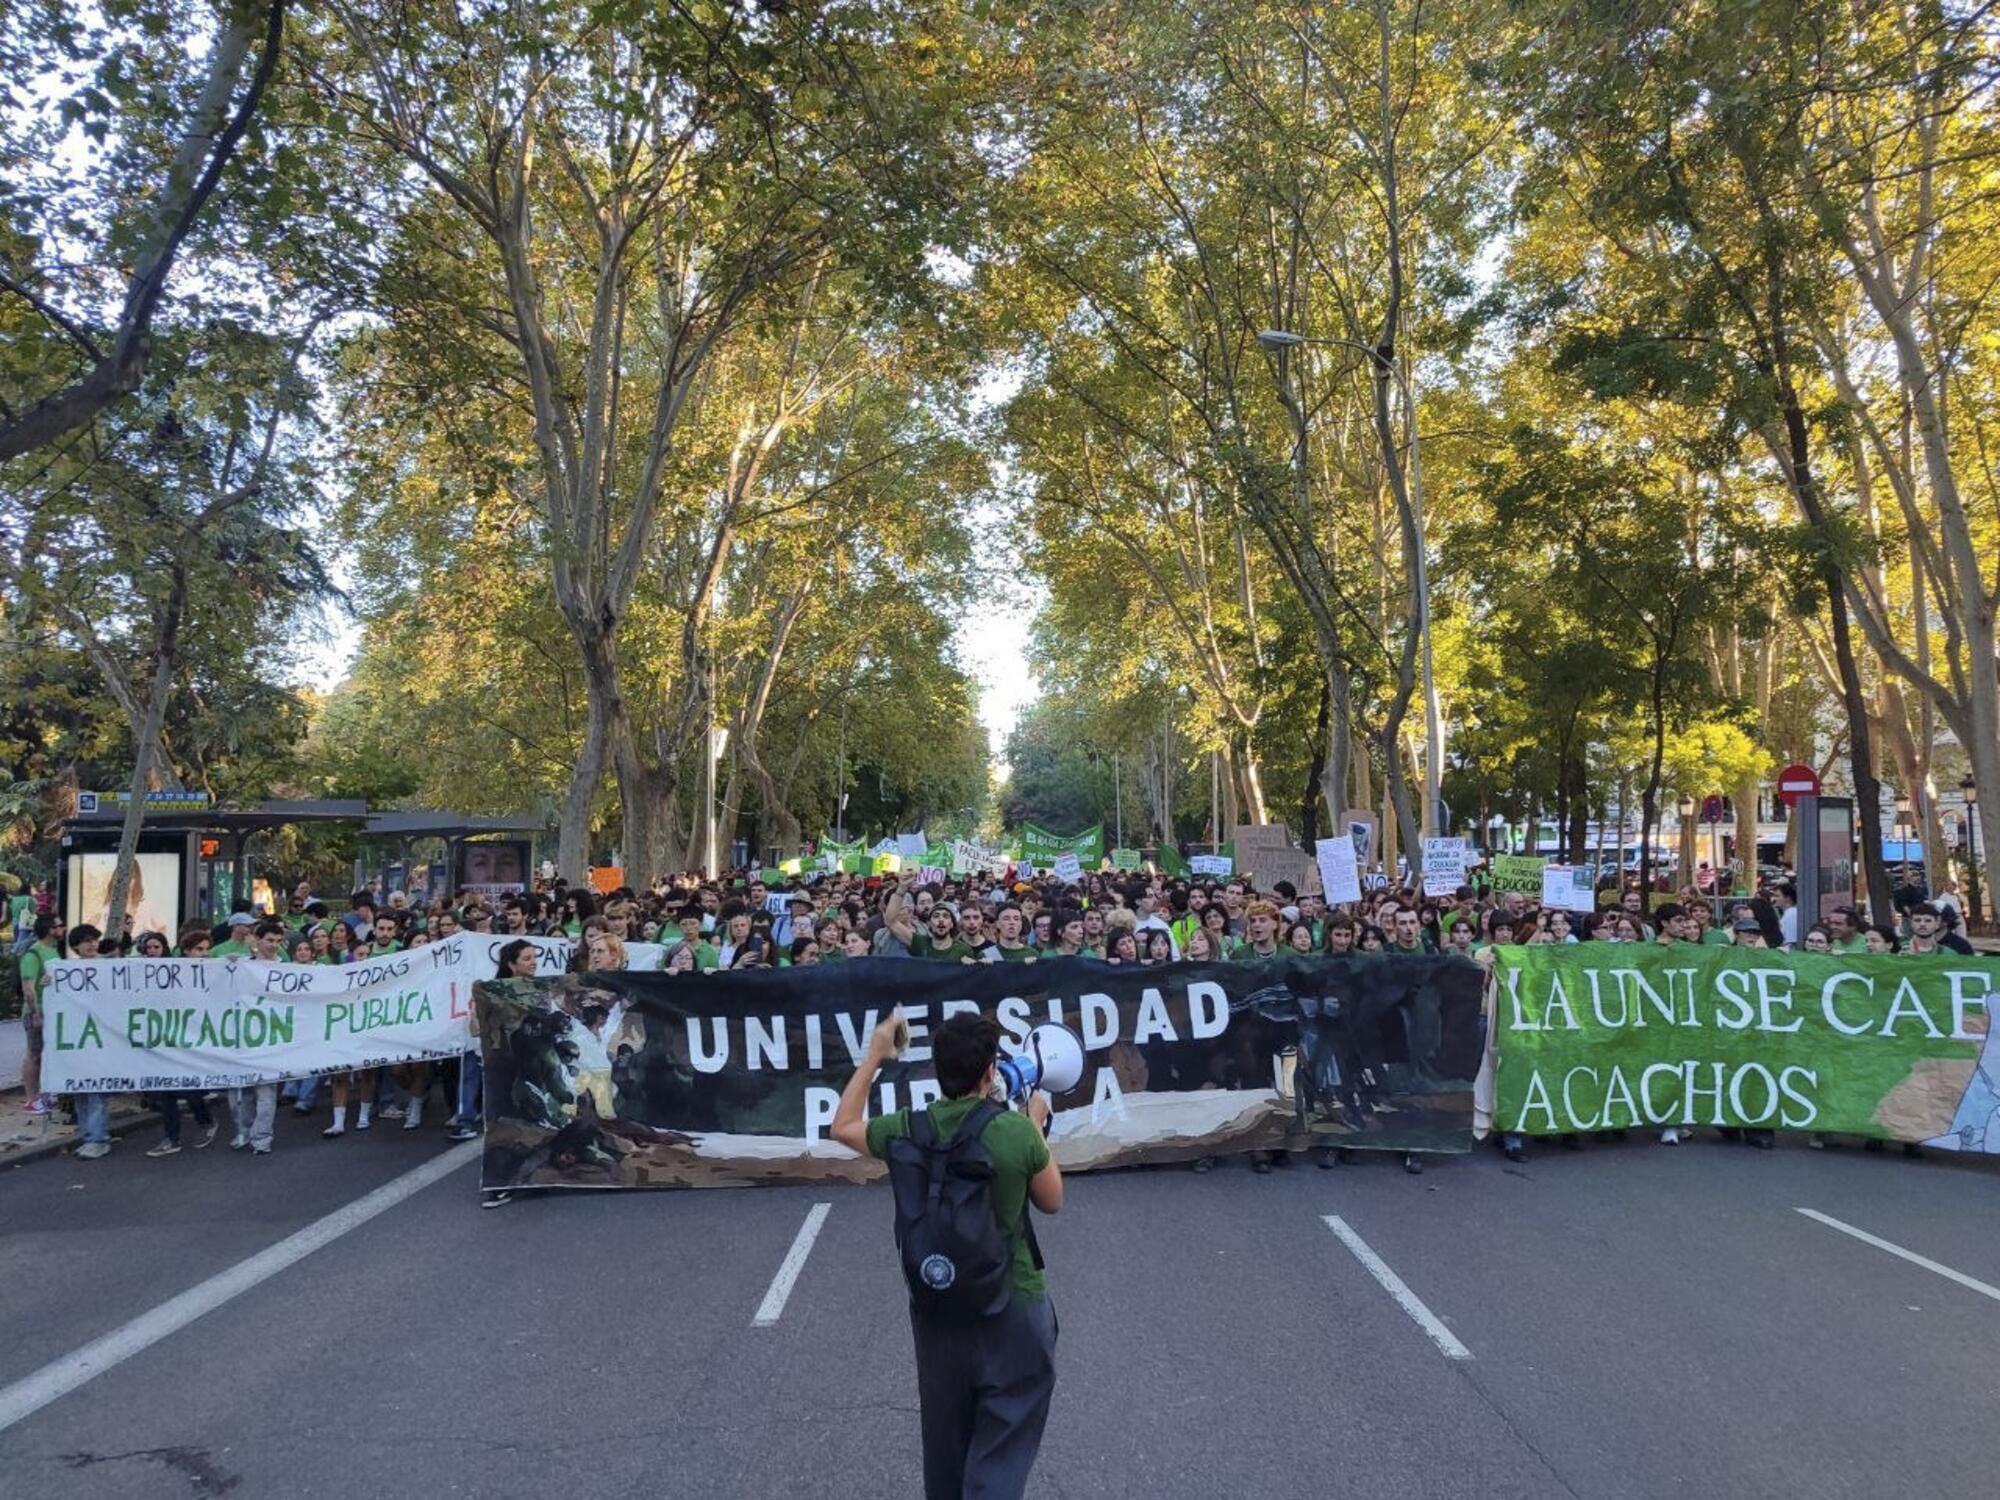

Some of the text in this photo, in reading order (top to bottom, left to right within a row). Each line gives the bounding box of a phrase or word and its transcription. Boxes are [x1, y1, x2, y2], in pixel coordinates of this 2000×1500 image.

[917, 866, 944, 884] NO
[1365, 875, 1387, 890] NO
[54, 967, 100, 993] POR
[144, 964, 184, 990] POR
[225, 964, 239, 989] Y
[265, 969, 314, 993] POR
[345, 957, 410, 992] TODAS
[432, 939, 464, 969] MIS
[55, 1011, 104, 1051] LA
[127, 996, 295, 1050] EDUCACIÓN
[323, 989, 433, 1041] PÚBLICA
[1715, 967, 1805, 1034] SE
